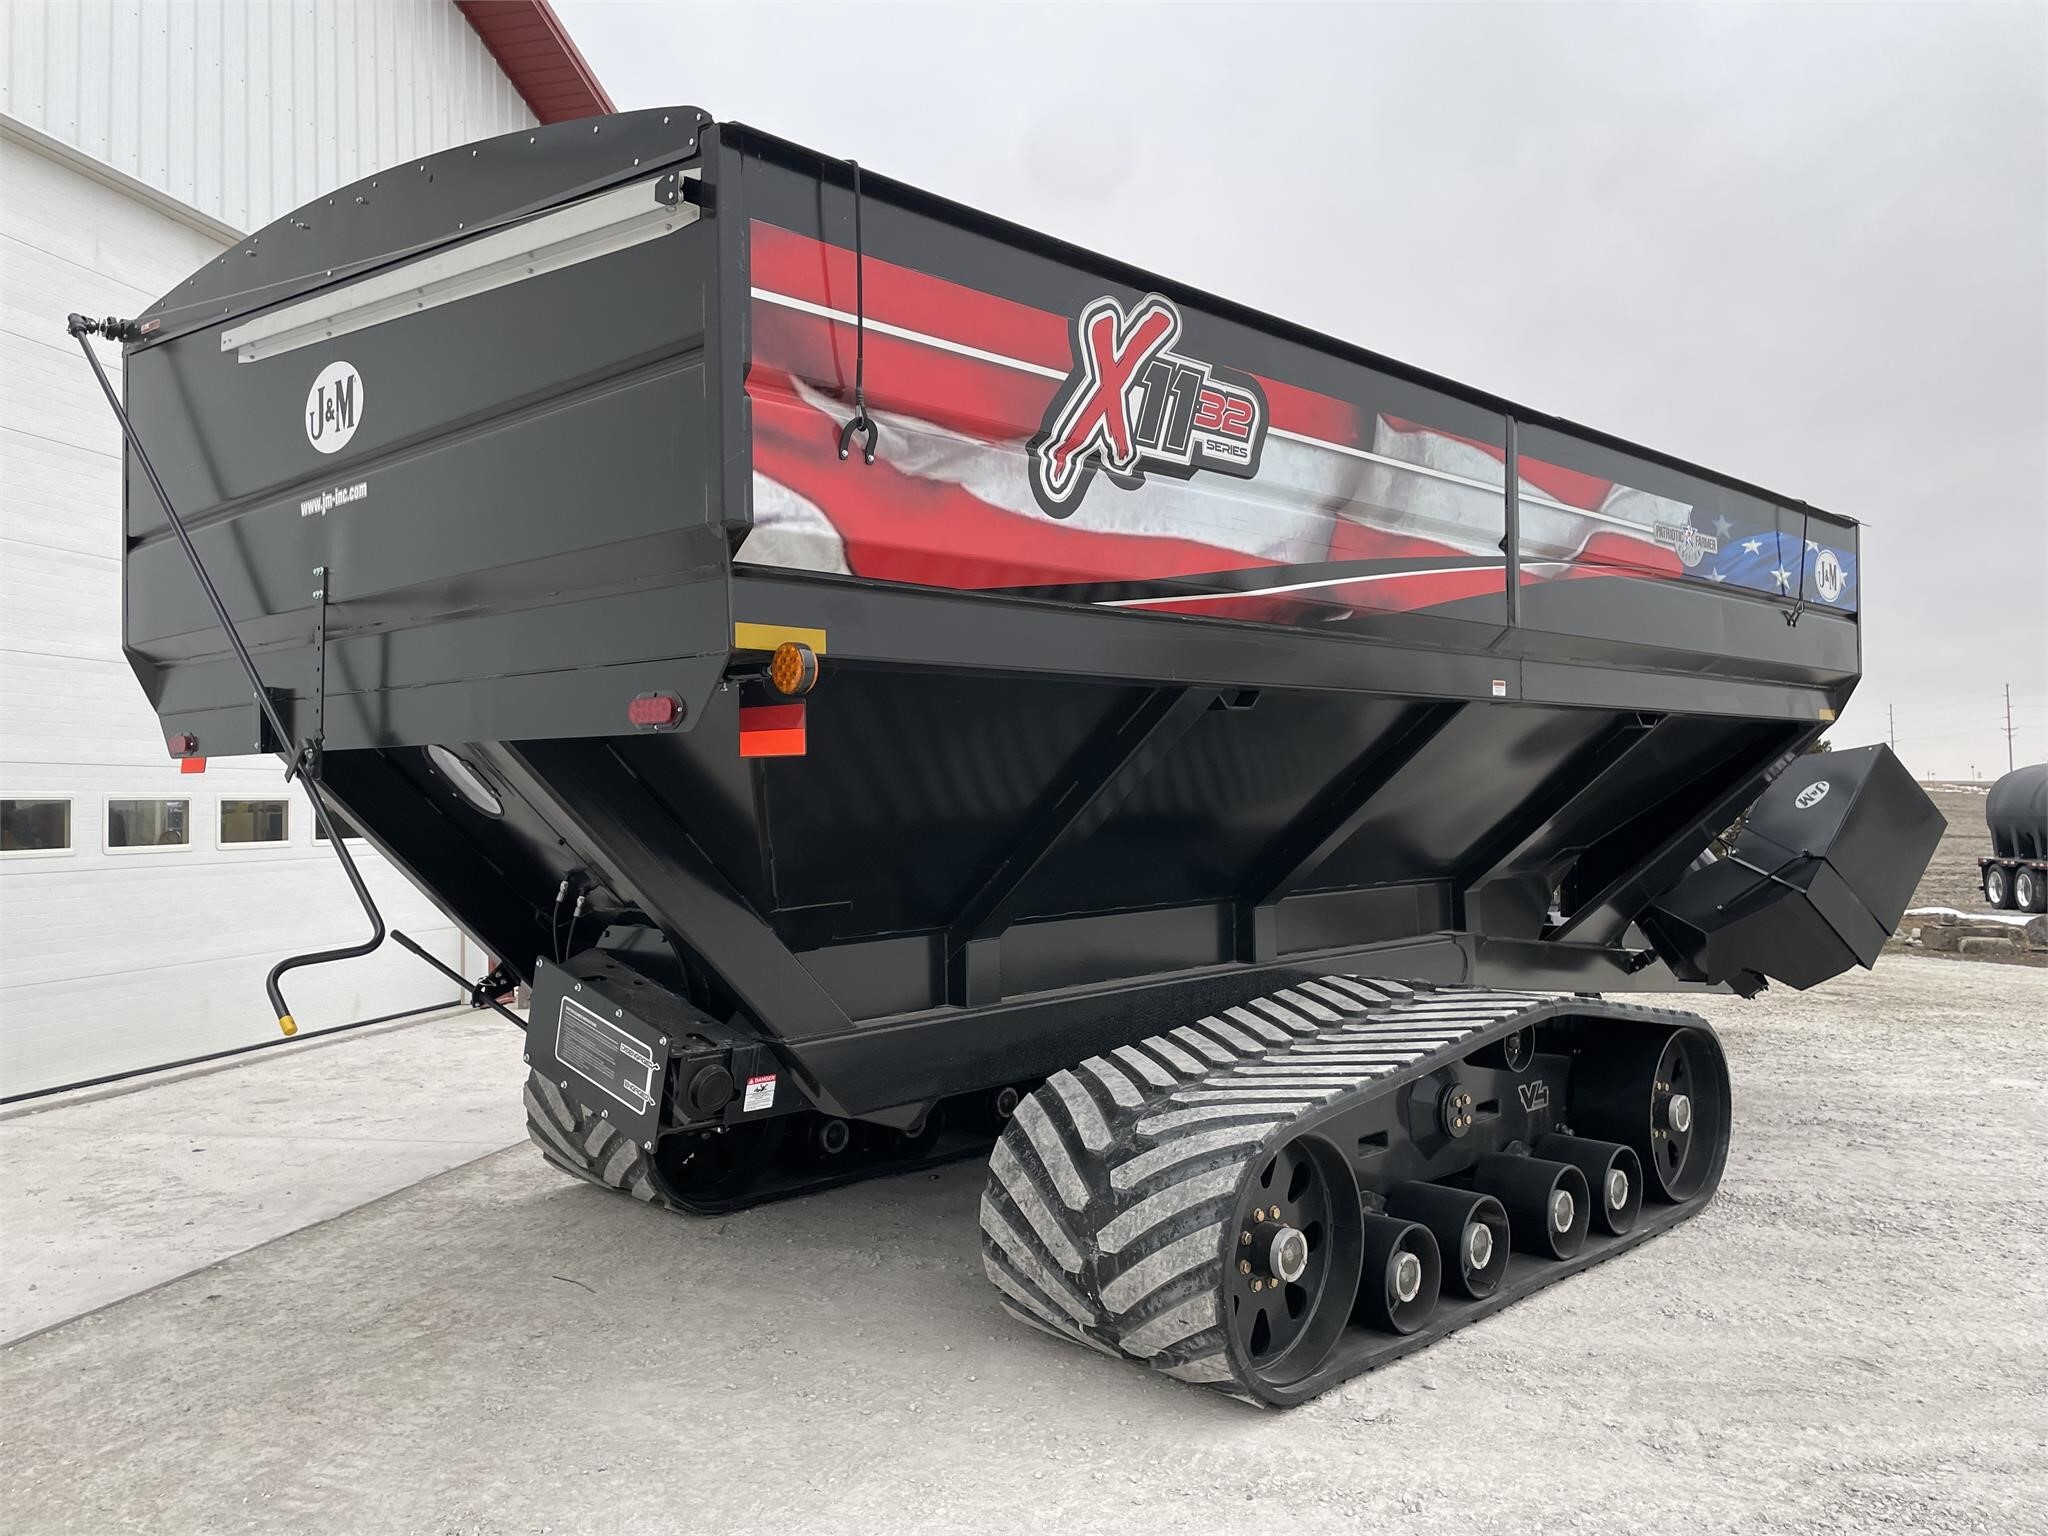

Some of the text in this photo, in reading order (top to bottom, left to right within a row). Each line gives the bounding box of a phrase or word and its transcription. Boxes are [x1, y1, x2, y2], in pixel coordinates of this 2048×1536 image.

[310, 374, 355, 441] J&M
[1206, 439, 1248, 458] SERIES
[300, 481, 368, 517] www.jm-inc.com
[1695, 535, 1717, 551] FARMER
[1818, 560, 1837, 591] J&M
[754, 1075, 776, 1083] DANGER
